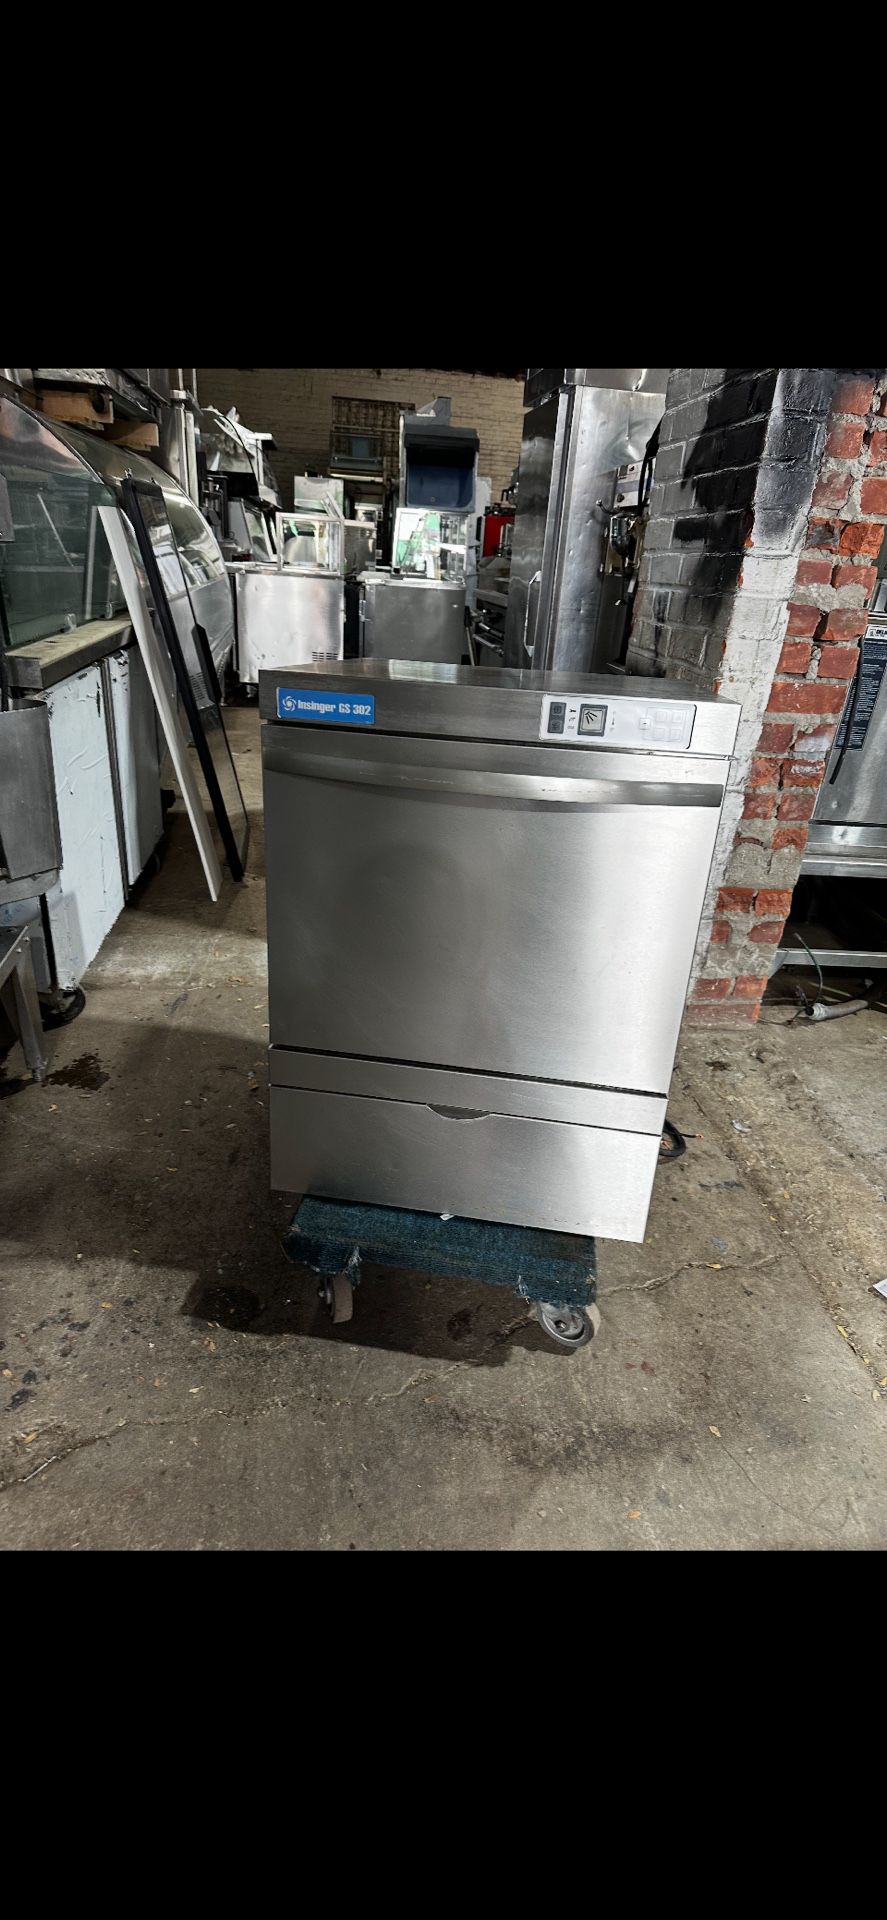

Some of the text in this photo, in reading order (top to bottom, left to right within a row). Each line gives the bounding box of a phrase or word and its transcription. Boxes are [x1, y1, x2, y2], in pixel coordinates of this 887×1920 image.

[297, 700, 371, 716] Insinger GS 302
